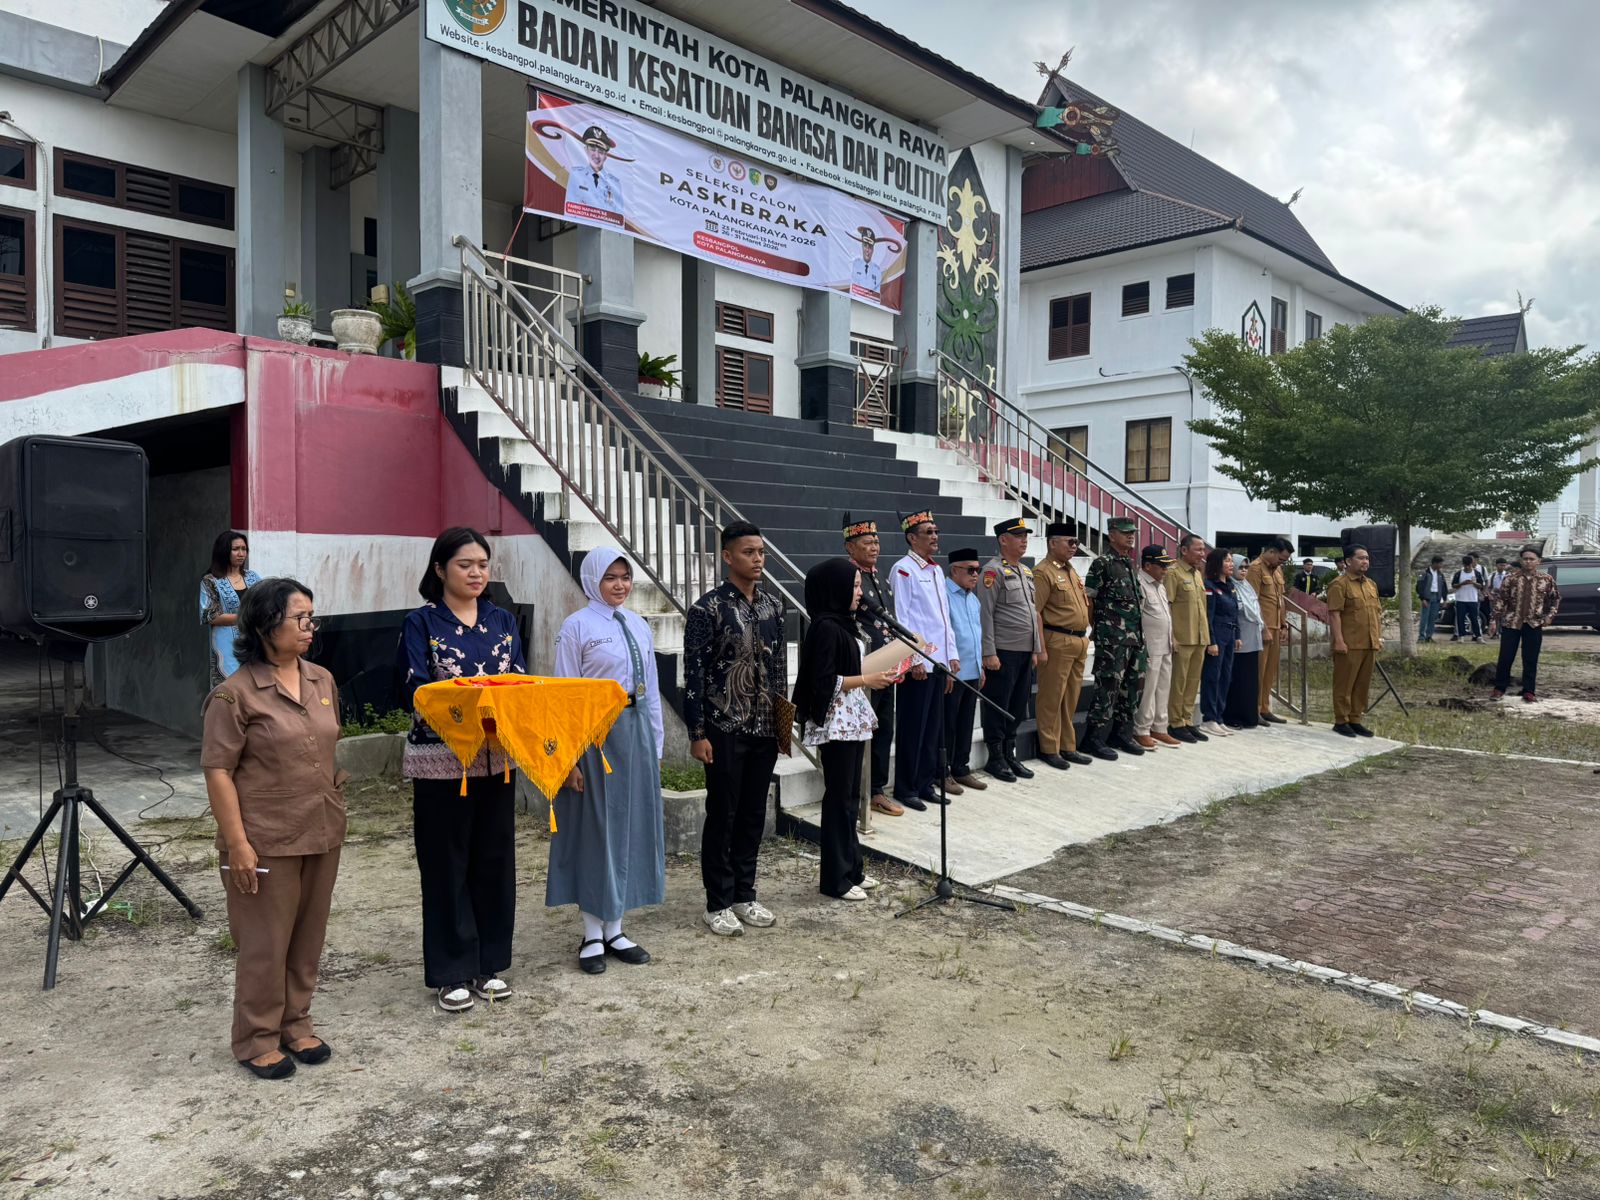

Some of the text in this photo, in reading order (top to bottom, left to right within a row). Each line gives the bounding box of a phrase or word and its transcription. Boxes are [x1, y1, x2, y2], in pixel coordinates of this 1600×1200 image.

[485, 41, 627, 102] kesbangpol.palangkaraya.go.id
[517, 1, 947, 208] BADAN KESATUAN BANGSA DAN POLITIK
[708, 45, 771, 93] KOTA
[780, 77, 893, 143] PALANGKA
[899, 128, 947, 167] RAYA
[660, 172, 828, 237] PASKIBRAKA
[686, 168, 796, 213] SELEKSI CALON
[883, 191, 898, 203] kota
[669, 195, 817, 248] KOTA PALANGKARAYA 2026
[696, 233, 740, 252] KESBANGPOL
[696, 239, 767, 265] KOTA PALANGKARAYA
[763, 242, 780, 251] 2026
